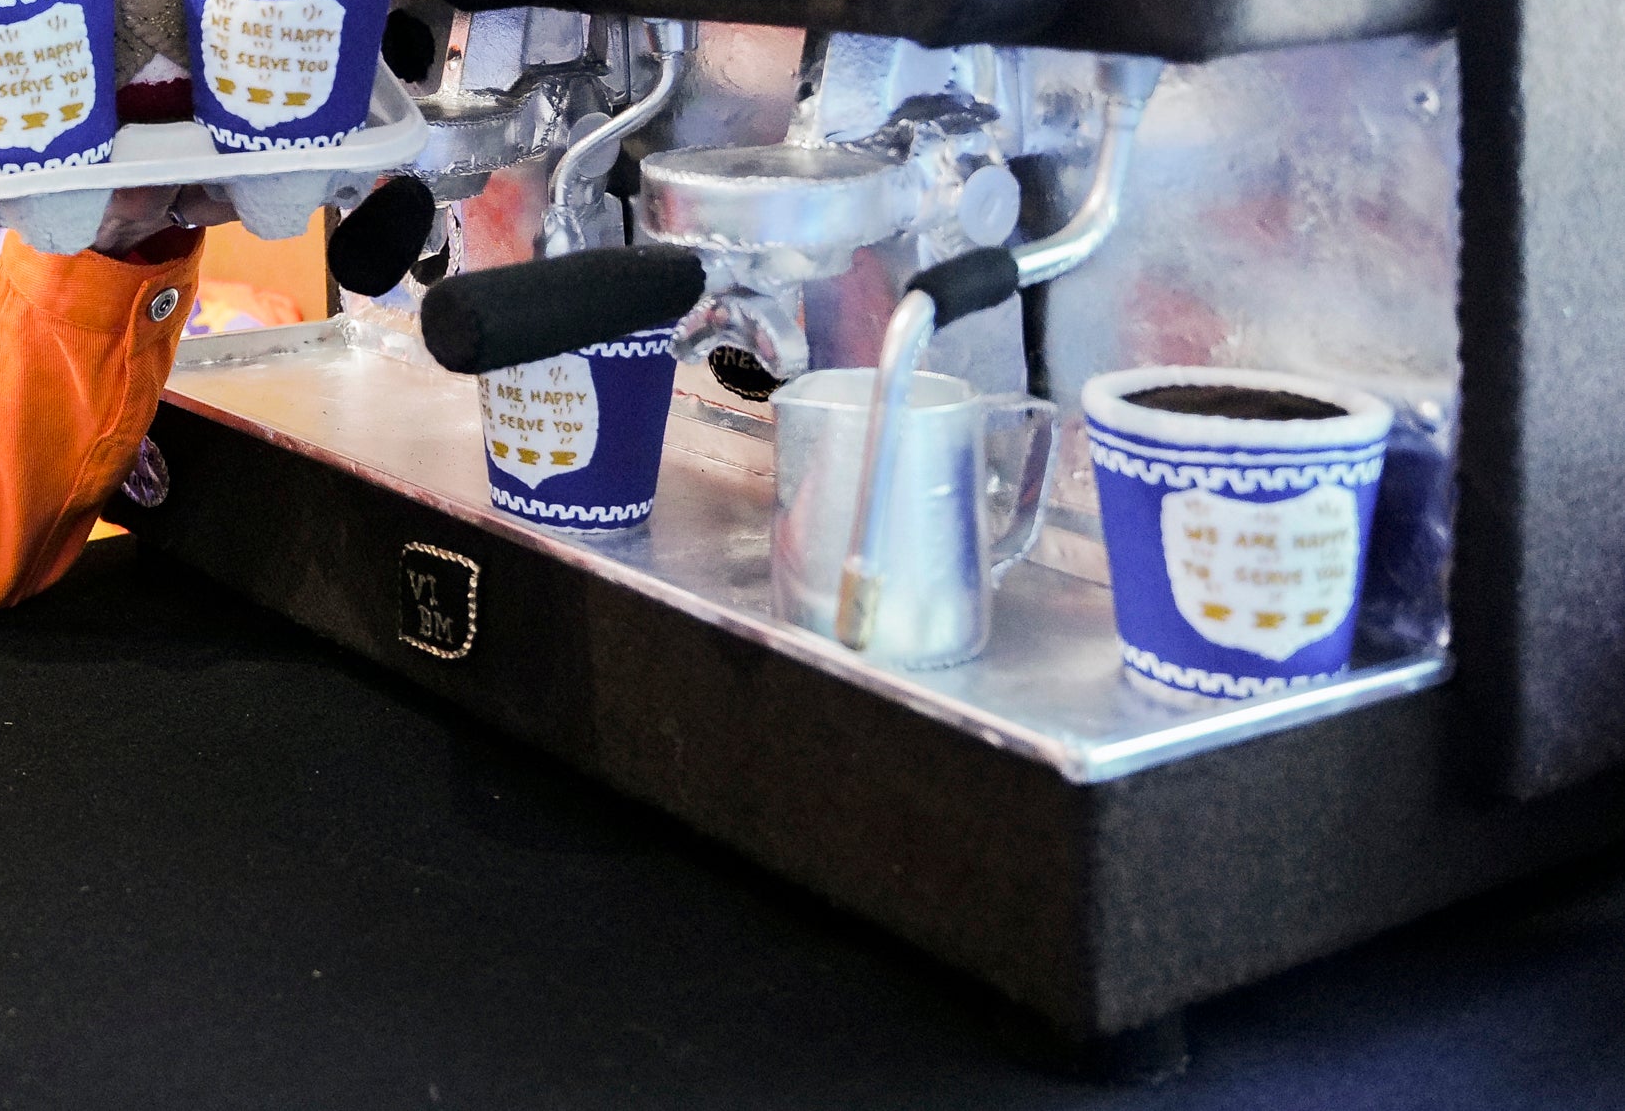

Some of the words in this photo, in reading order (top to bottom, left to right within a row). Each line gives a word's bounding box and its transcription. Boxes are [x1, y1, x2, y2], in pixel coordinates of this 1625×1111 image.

[211, 12, 231, 31] WE
[241, 21, 274, 39] ARE
[280, 27, 335, 43] HAPPY
[34, 39, 83, 63] HAPPY
[210, 44, 229, 61] TO
[236, 51, 290, 72] SERVE
[297, 59, 328, 73] YOU
[60, 67, 88, 86] YOU
[497, 383, 524, 402] ARE
[530, 390, 587, 407] HAPPY
[499, 414, 544, 432] SERVE
[553, 421, 583, 433] YOU
